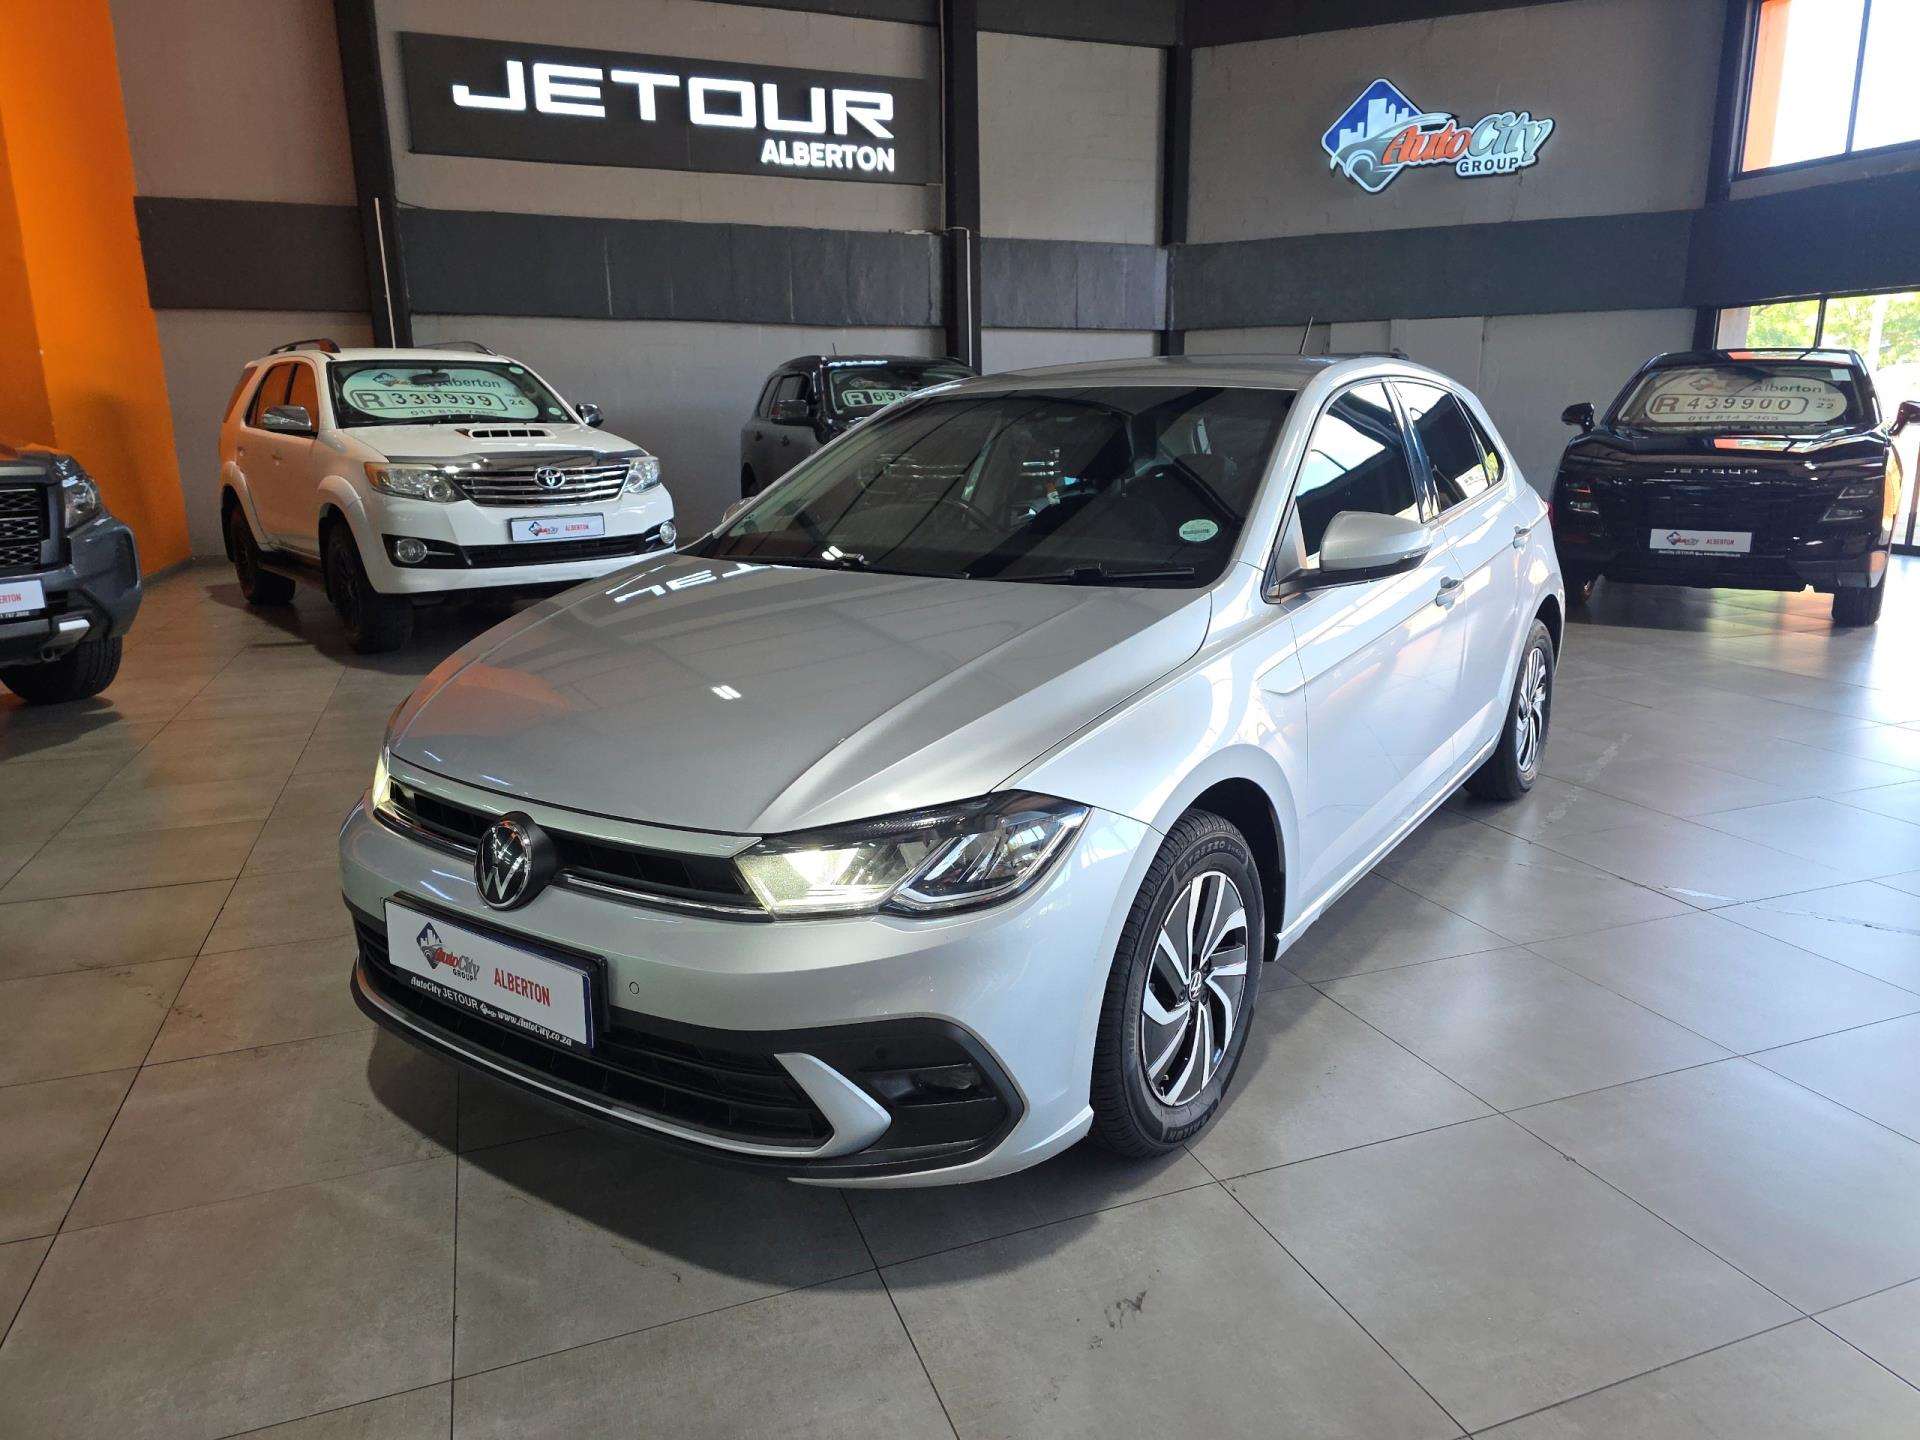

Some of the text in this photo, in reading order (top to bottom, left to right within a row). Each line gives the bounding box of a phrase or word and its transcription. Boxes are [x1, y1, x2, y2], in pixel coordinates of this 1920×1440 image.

[452, 60, 896, 139] JETOUR
[760, 139, 896, 172] ALBERTON
[1458, 157, 1520, 174] GROUP
[1687, 397, 1792, 411] 439900
[1751, 384, 1823, 393] Alberton
[410, 976, 441, 998] AutoCity
[443, 987, 479, 1010] JETOUR
[494, 968, 551, 1005] ALBERTON
